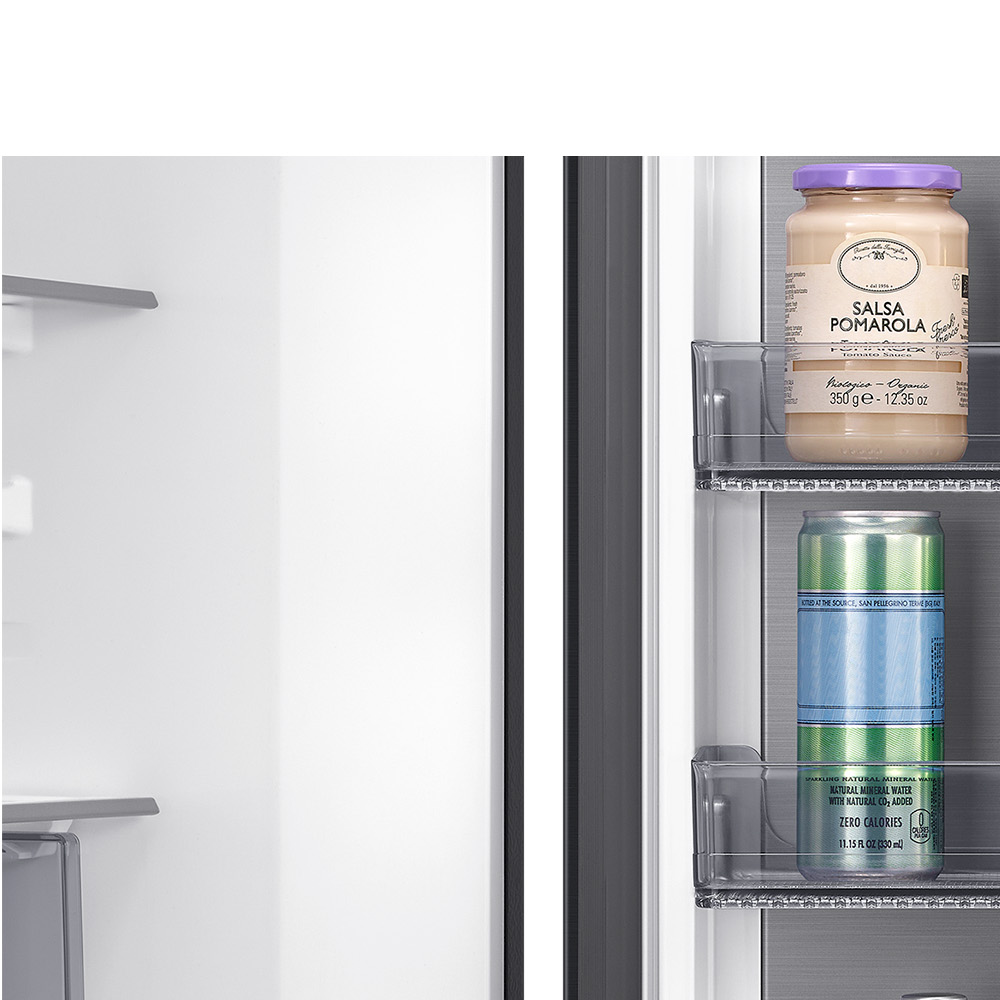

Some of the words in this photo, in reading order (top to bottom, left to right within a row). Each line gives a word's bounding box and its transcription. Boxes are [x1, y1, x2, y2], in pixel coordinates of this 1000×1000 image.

[852, 301, 905, 316] SALSA
[830, 317, 927, 333] POMAROLA
[825, 376, 872, 394] Biologico
[887, 378, 930, 396] Organic
[830, 392, 849, 405] 350
[885, 392, 914, 405] 12.35
[917, 396, 928, 406] oz
[830, 785, 858, 795] NATURAL
[860, 785, 890, 795] MINERAL
[891, 785, 912, 795] WATER
[829, 797, 844, 806] WITH
[846, 797, 876, 806] NATURAL
[892, 797, 913, 806] ADDED
[839, 817, 860, 828] ZERO
[864, 817, 903, 828] CALORIES
[839, 839, 856, 849] 11.15
[857, 840, 865, 849] FL
[866, 839, 877, 849] OZ
[877, 839, 892, 850] (330
